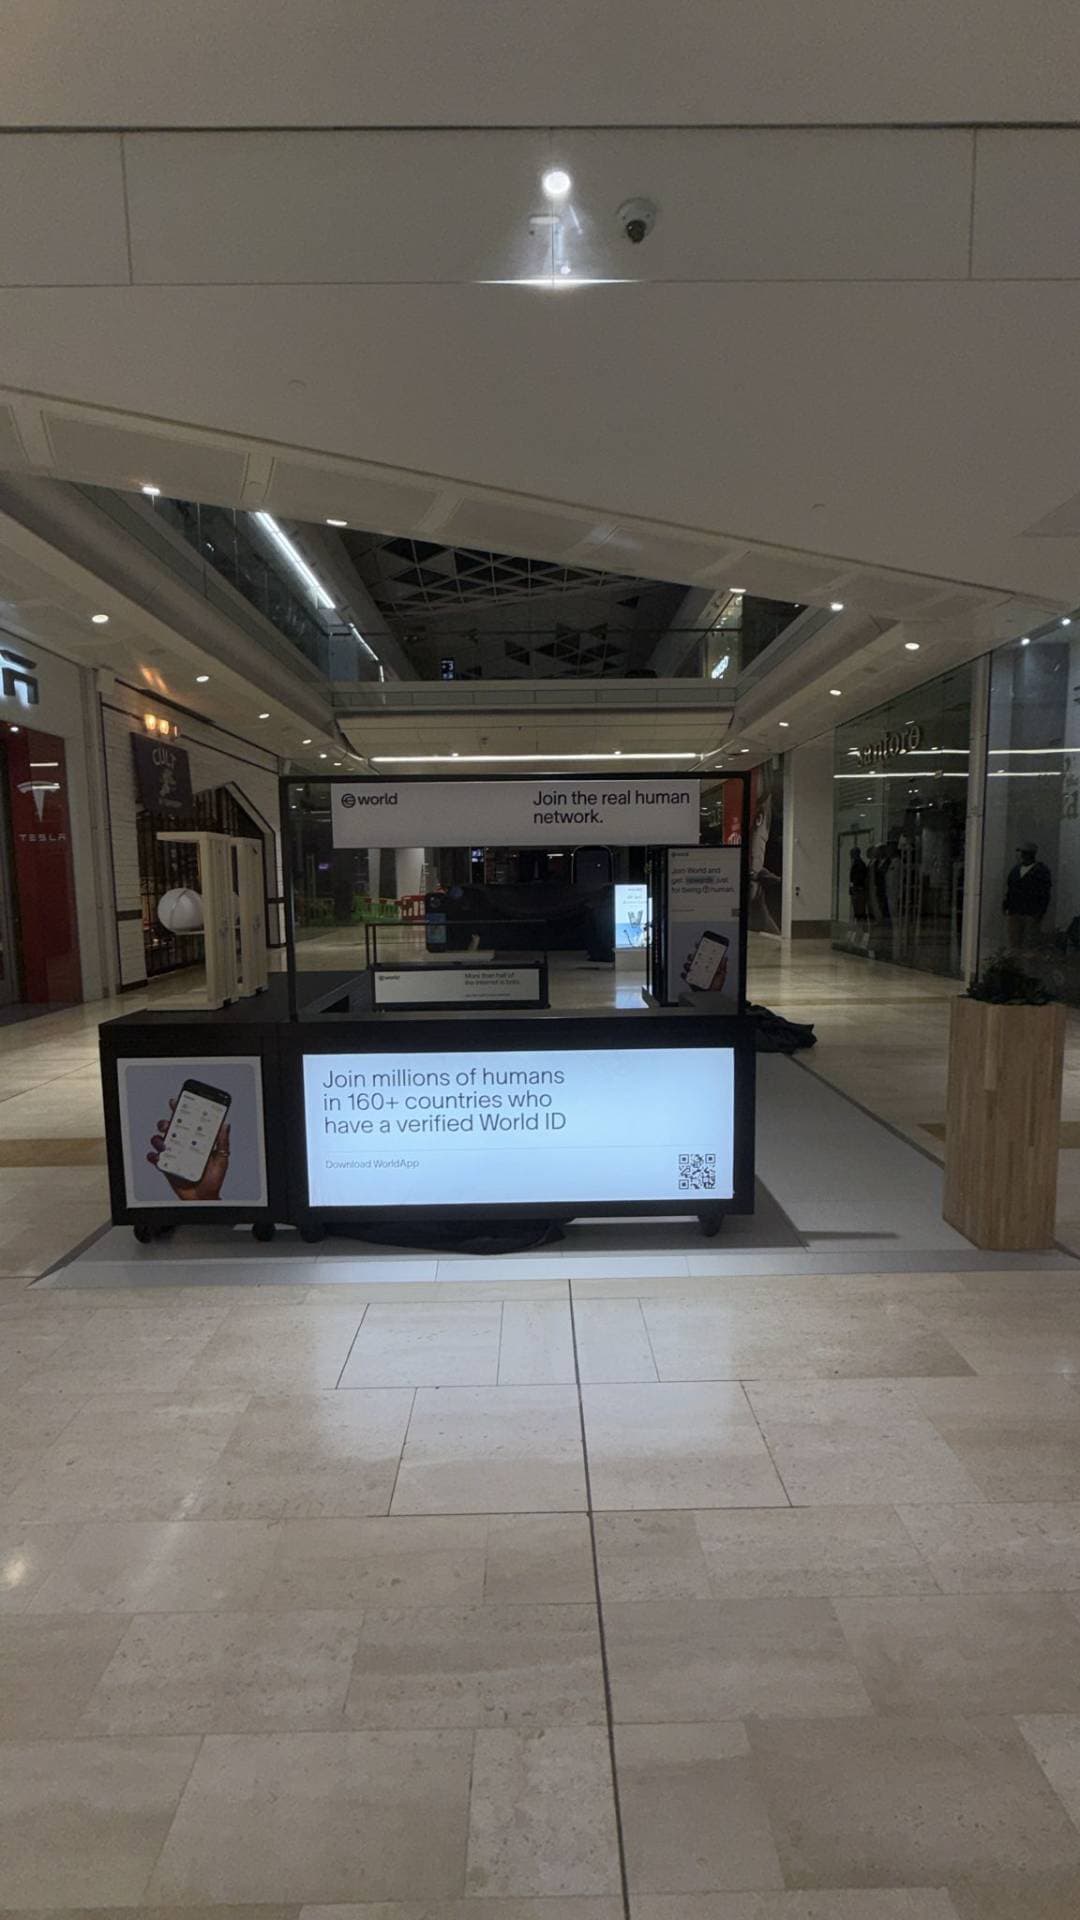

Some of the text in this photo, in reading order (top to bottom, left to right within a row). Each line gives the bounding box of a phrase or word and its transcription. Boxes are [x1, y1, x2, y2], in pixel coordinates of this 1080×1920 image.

[357, 792, 398, 806] world
[533, 790, 690, 806] Join the real human
[533, 809, 603, 824] network.
[18, 833, 66, 842] TESLA
[323, 1068, 565, 1088] Join millions of humans
[324, 1090, 552, 1111] in 160+ countries who
[325, 1112, 566, 1134] have a verified World ID
[325, 1159, 420, 1169] Download WorldApp
